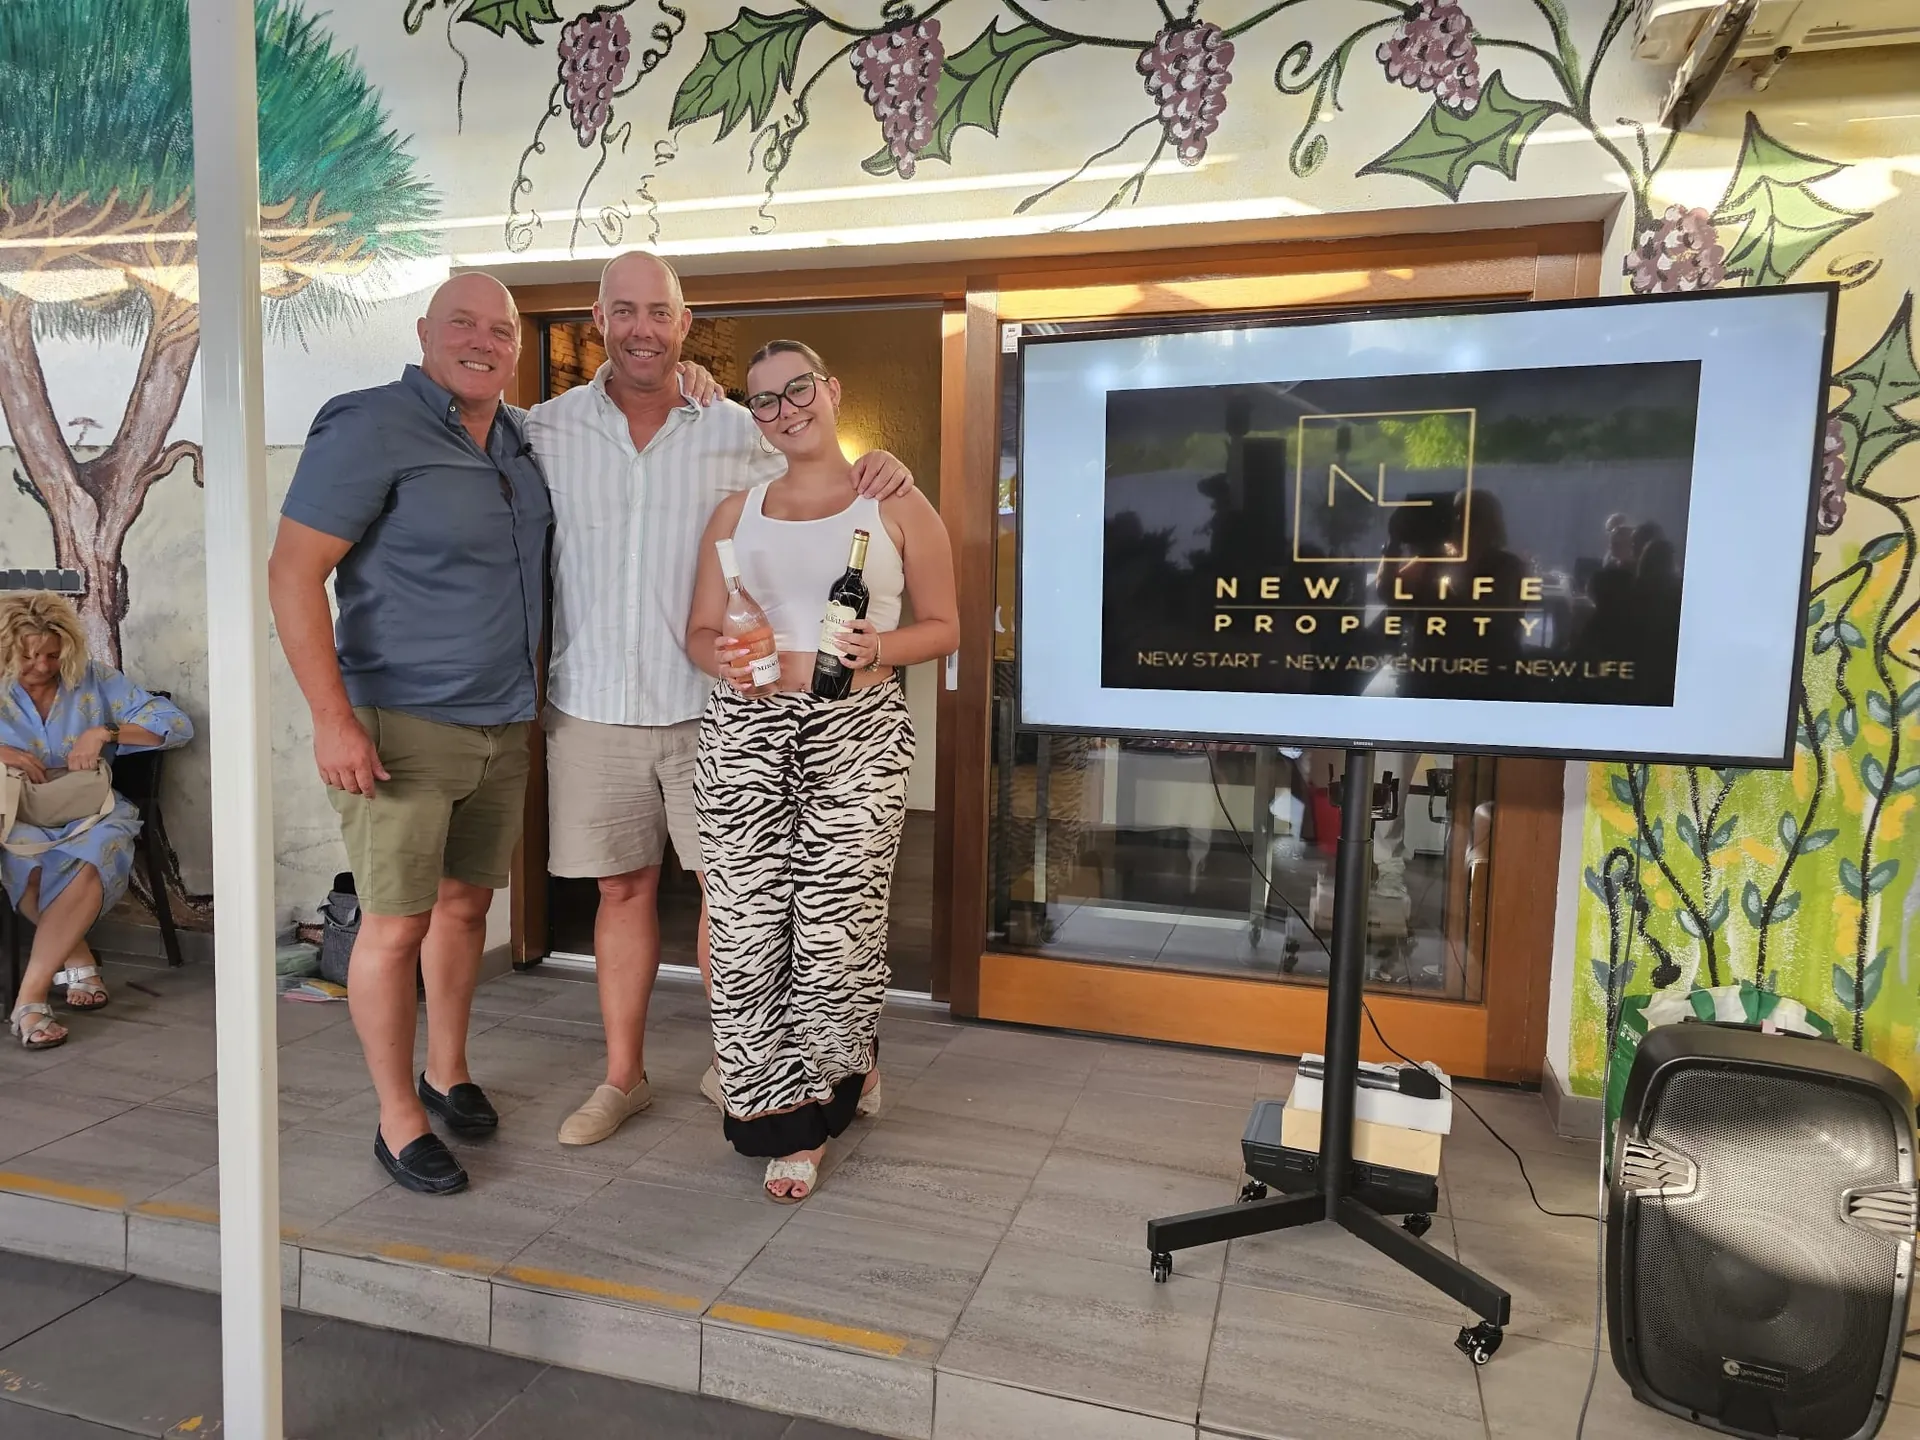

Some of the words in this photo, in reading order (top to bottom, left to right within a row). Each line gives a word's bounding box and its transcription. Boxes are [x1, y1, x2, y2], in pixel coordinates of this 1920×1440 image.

[1327, 463, 1433, 508] NL
[1216, 576, 1340, 600] NEW
[1394, 576, 1544, 601] LIFE
[1214, 613, 1541, 637] PROPERTY
[1137, 650, 1188, 668] NEW
[1192, 651, 1263, 669] START
[1285, 654, 1340, 672] NEW
[1514, 659, 1578, 678] NEW
[1583, 660, 1636, 680] LIFE
